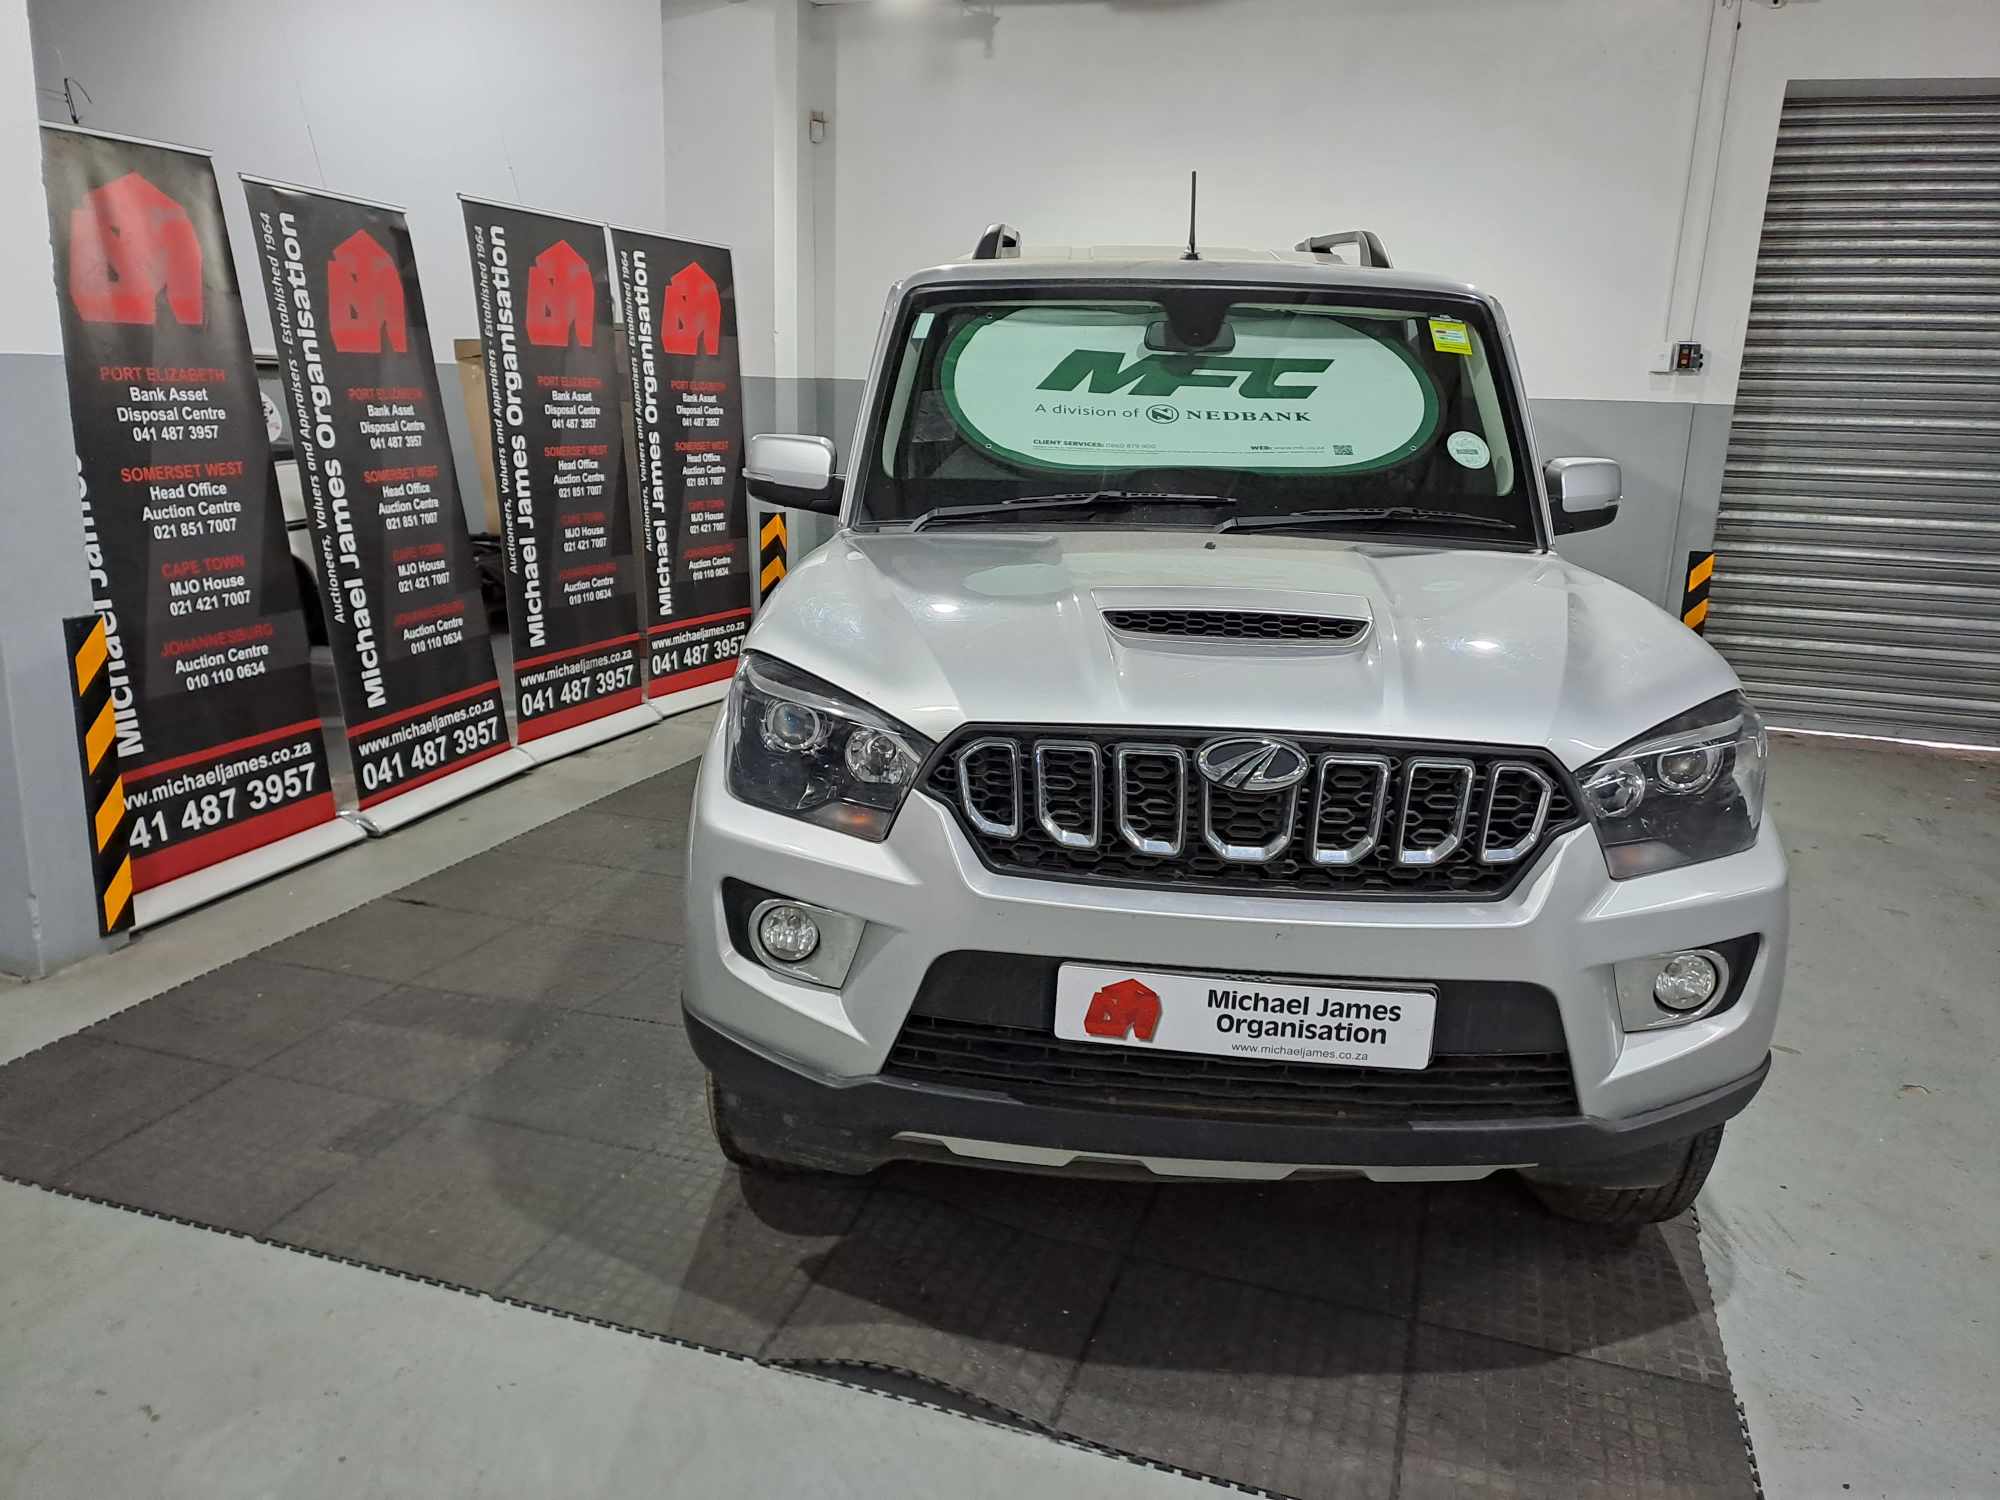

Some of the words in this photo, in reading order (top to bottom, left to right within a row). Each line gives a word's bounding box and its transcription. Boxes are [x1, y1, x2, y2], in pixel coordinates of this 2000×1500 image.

[260, 212, 276, 251] 1964
[267, 255, 294, 345] Established
[477, 261, 494, 337] Established
[279, 212, 336, 449] Organisation
[490, 225, 523, 426] Organisation
[633, 250, 657, 424] Organisation
[100, 366, 141, 382] PORT
[147, 367, 225, 382] ELIZABETH
[488, 349, 504, 417] Appraisers
[1035, 348, 1335, 399] MFC
[129, 387, 166, 402] Bank
[169, 387, 208, 401] Asset
[288, 359, 311, 439] Appraisers
[552, 390, 570, 401] Bank
[117, 407, 179, 425] Disposal
[182, 406, 226, 421] Centre
[367, 404, 390, 416] Bank
[392, 405, 415, 416] Asset
[545, 404, 576, 416] Disposal
[1035, 404, 1046, 414] A
[1052, 404, 1117, 417] division
[1122, 408, 1141, 417] of
[1186, 410, 1312, 422] NEDBANK
[133, 426, 157, 442] 041
[161, 425, 184, 440] 487
[189, 425, 219, 439] 3957
[360, 421, 399, 434] Disposal
[401, 420, 425, 431] Centre
[494, 419, 504, 444] and
[552, 419, 564, 429] 041
[635, 417, 644, 439] and
[370, 437, 385, 450] 041
[388, 436, 402, 448] 487
[406, 435, 422, 447] 3957
[302, 441, 317, 472] and
[120, 463, 201, 482] SOMERSET
[205, 461, 243, 477] WEST
[498, 447, 510, 494] Valuers
[511, 435, 534, 529] James
[554, 474, 580, 485] Auction
[648, 432, 664, 513] James
[150, 484, 185, 500] Head
[188, 482, 227, 497] Office
[310, 475, 327, 529] Valuers
[382, 485, 404, 498] Head
[406, 482, 431, 495] Office
[559, 487, 571, 498] 021
[142, 504, 195, 521] Auction
[198, 501, 241, 517] Centre
[325, 459, 360, 569] James
[378, 501, 411, 515] Auction
[414, 498, 439, 509] Centre
[153, 524, 177, 540] 021
[181, 521, 204, 537] 851
[208, 518, 237, 534] 7007
[386, 518, 401, 530] 021
[403, 516, 418, 527] 851
[420, 512, 438, 524] 7007
[581, 526, 604, 536] House
[564, 542, 576, 552] 021
[162, 562, 201, 578] CAPE
[205, 555, 246, 572] TOWN
[398, 563, 417, 577] MJO
[419, 559, 445, 573] House
[653, 520, 672, 616] Michael
[169, 580, 200, 597] MJO
[203, 574, 245, 591] House
[322, 535, 346, 624] Auctioneers,
[398, 580, 413, 593] 021
[415, 577, 430, 590] 421
[432, 572, 450, 586] 7007
[564, 581, 590, 593] Auction
[169, 599, 192, 617] 021
[196, 595, 219, 613] 421
[223, 590, 251, 608] 7007
[519, 537, 545, 648] Michael
[403, 625, 436, 640] Auction
[437, 617, 463, 631] Centre
[652, 621, 744, 650] www.michaeljames.co.za
[344, 578, 386, 709] Michael
[411, 641, 425, 655] 010
[427, 636, 441, 650] 110
[652, 650, 678, 675] 041
[683, 643, 709, 666] 487
[714, 635, 745, 660] 3957
[175, 654, 225, 675] Auction
[227, 643, 269, 661] Centre
[520, 649, 632, 687] www.michaeljames.co.za
[186, 673, 209, 691] 010
[212, 668, 234, 685] 110
[236, 661, 266, 680] 0634
[522, 687, 554, 716] 041
[560, 677, 590, 704] 487
[596, 664, 634, 694] 3957
[358, 699, 495, 757] www.michaeljames.co.za
[363, 752, 404, 790] 041
[411, 735, 447, 770] 487
[453, 716, 498, 754] 3957
[129, 811, 168, 849] 41
[181, 787, 237, 831] 487
[247, 762, 316, 810] 3957
[1207, 989, 1310, 1016] Michael
[1316, 999, 1401, 1022] James
[1216, 1014, 1387, 1044] Organisation
[1231, 1042, 1369, 1061] www.michaeljames.co.za
